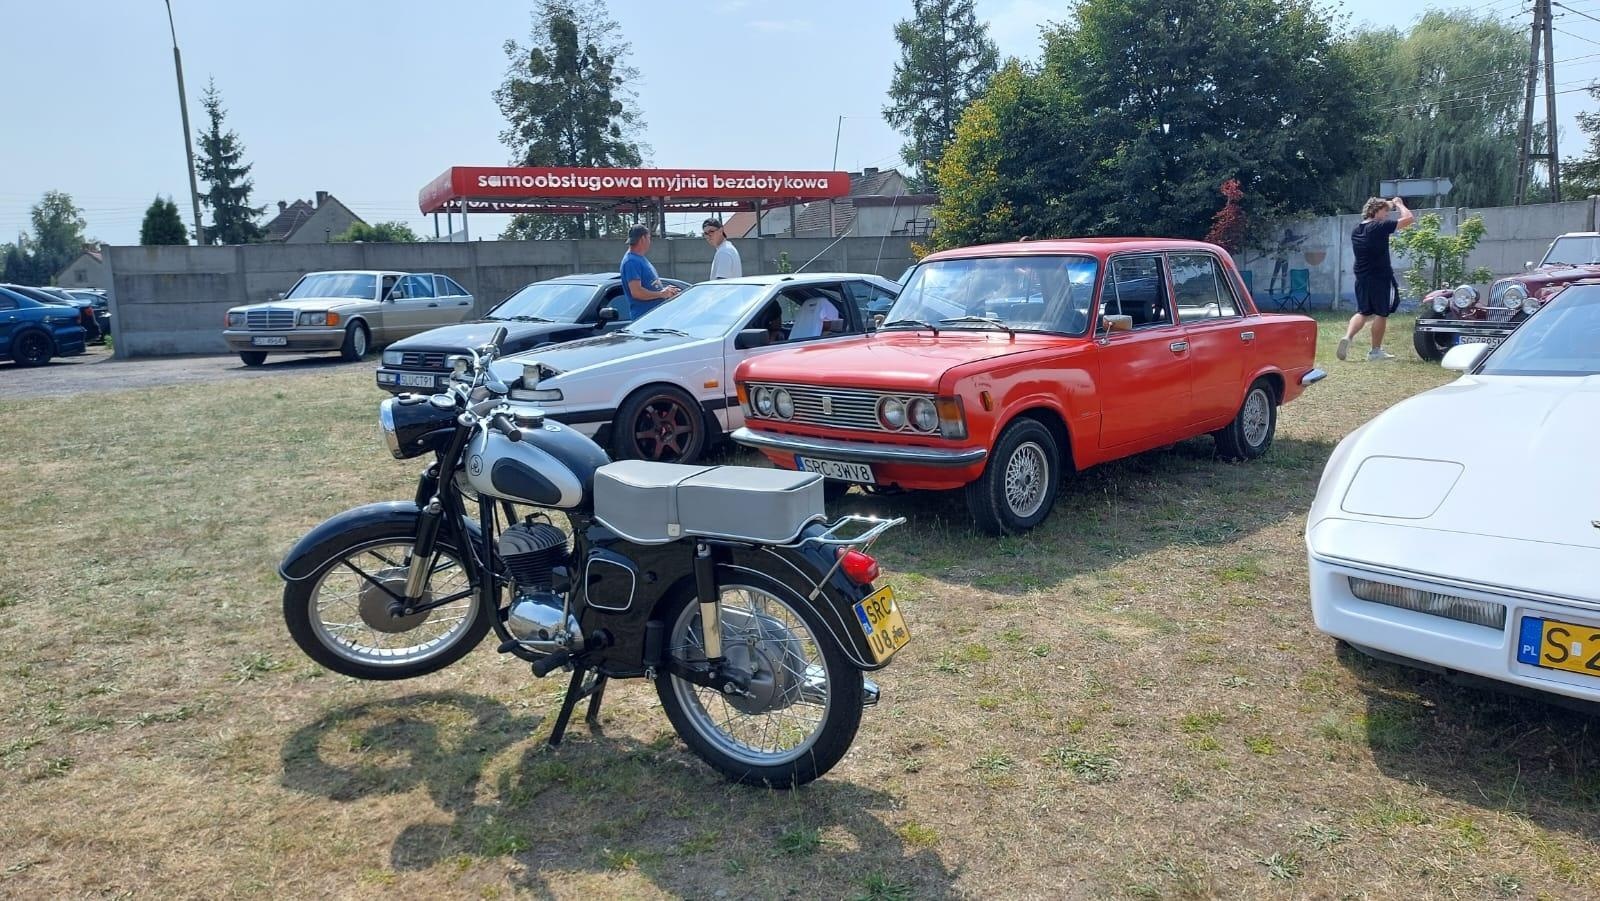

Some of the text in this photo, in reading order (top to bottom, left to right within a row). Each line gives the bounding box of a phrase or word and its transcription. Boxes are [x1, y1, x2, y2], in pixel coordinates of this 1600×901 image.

[478, 173, 829, 192] samoobsługowa myjnia bezdotykowa
[804, 459, 870, 481] SRC 3WV8
[866, 596, 892, 625] SRC
[1522, 645, 1538, 657] PL
[1544, 627, 1571, 664] S
